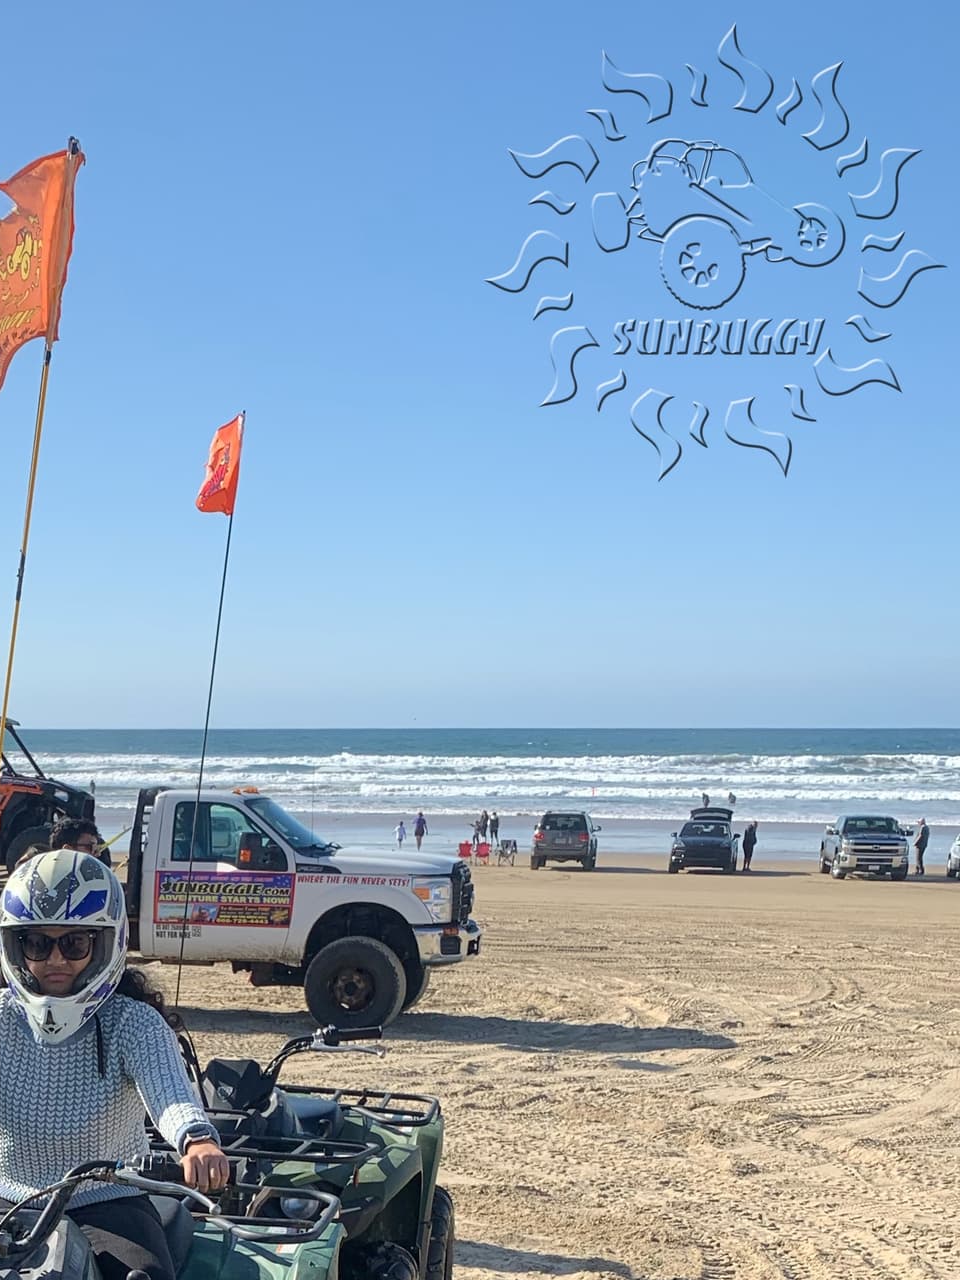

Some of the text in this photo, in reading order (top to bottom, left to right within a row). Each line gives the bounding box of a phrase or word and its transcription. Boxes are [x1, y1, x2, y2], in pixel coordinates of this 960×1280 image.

[297, 875, 324, 884] WHERE
[326, 876, 340, 885] THE
[342, 876, 359, 886] FUN
[360, 877, 386, 887] NEVER
[159, 893, 290, 905] ADVENTURE STARTS NOW!
